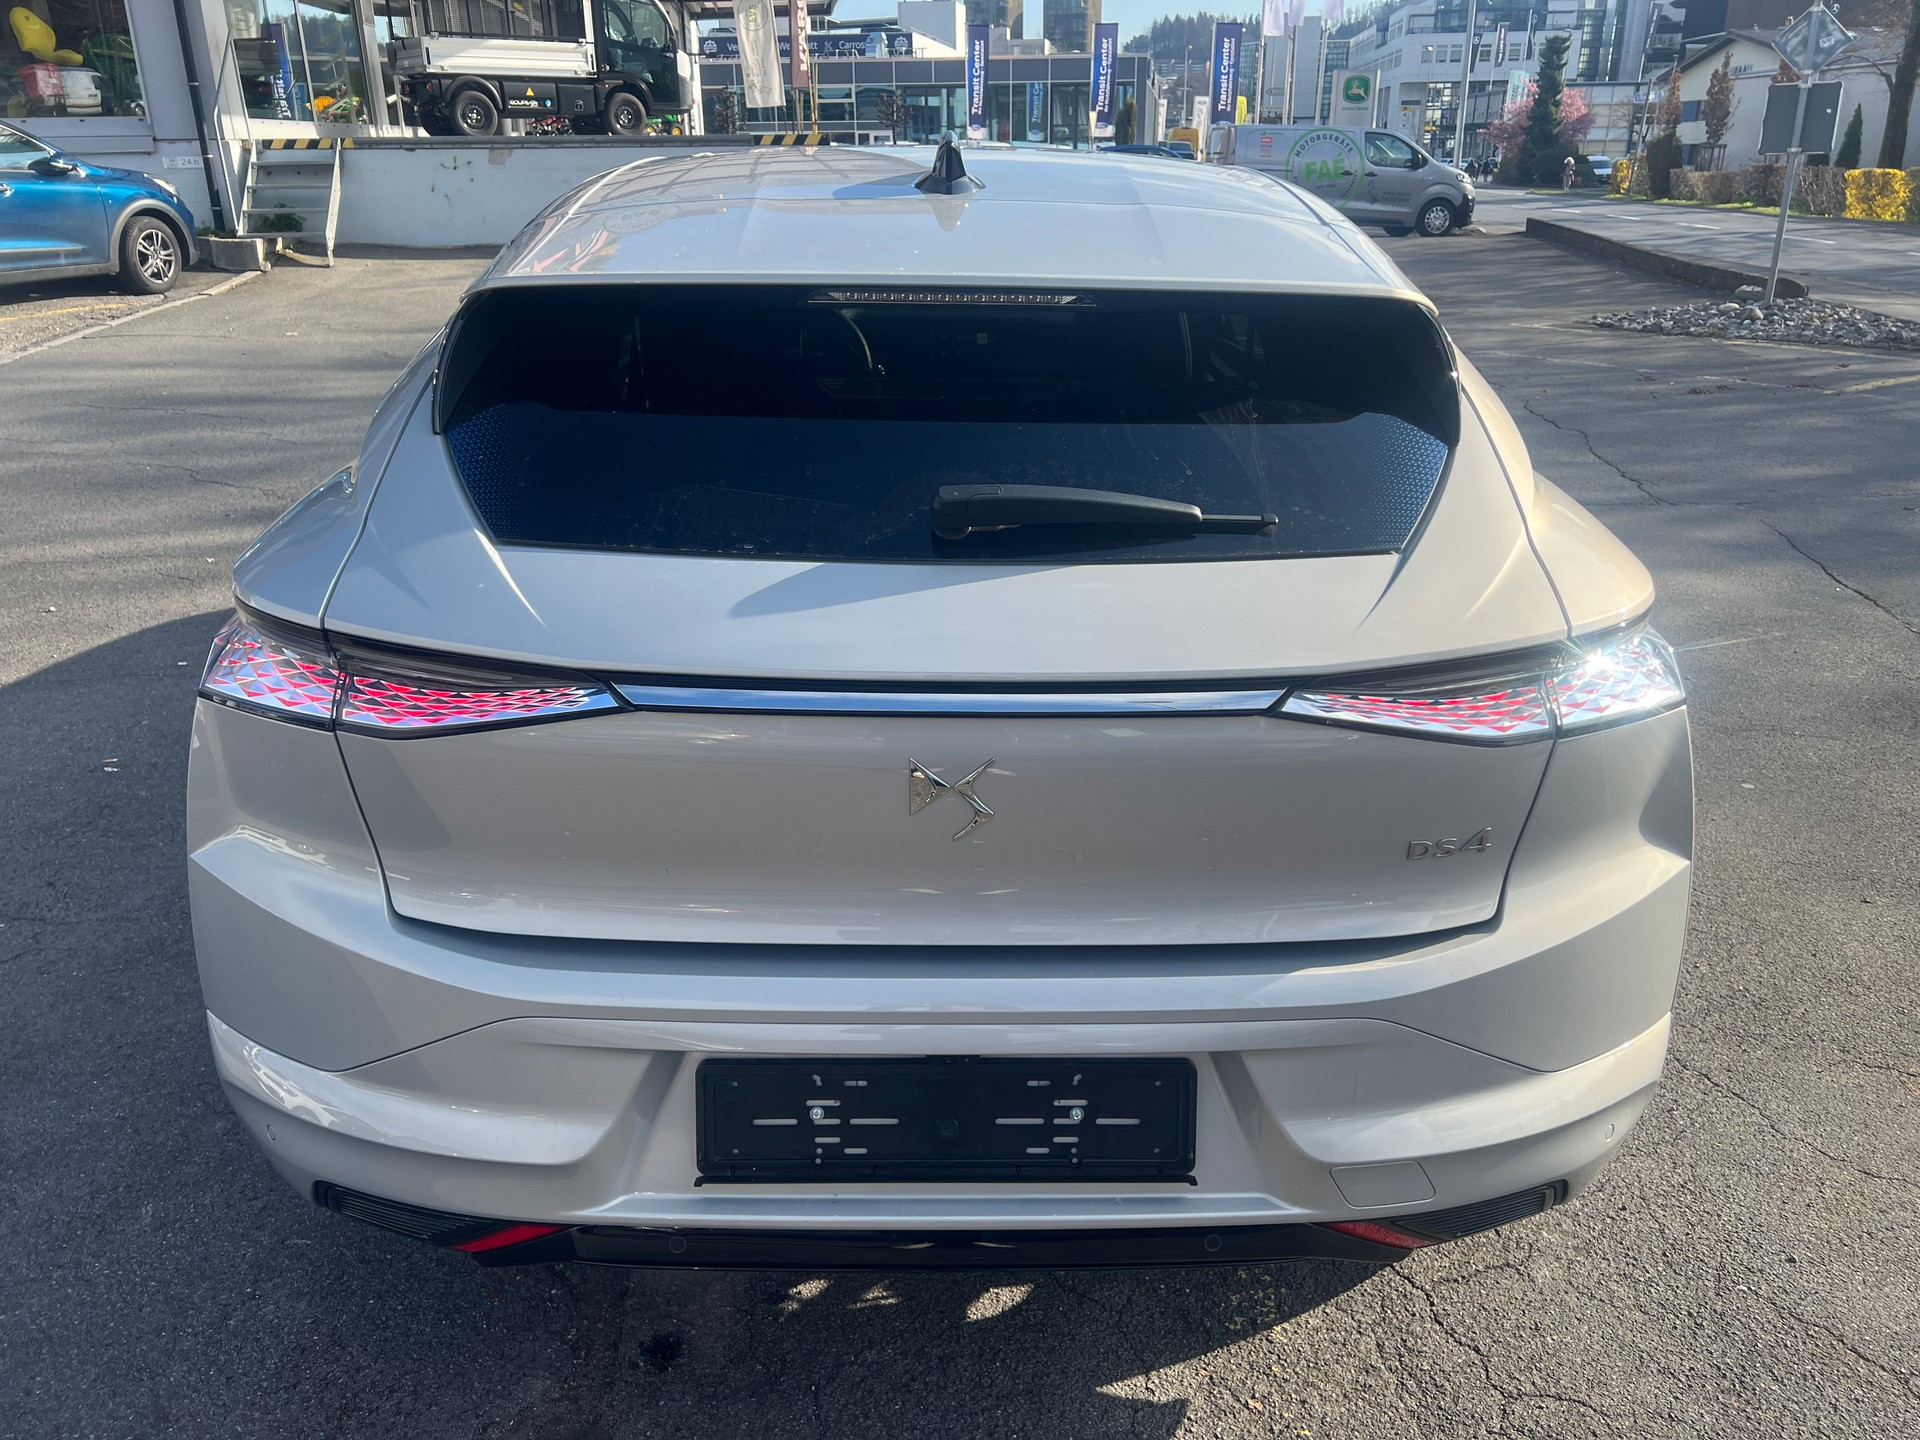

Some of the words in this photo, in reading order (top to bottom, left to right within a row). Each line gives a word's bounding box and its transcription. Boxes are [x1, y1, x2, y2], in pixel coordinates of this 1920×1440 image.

[838, 40, 866, 49] Carros
[972, 40, 980, 76] Center
[1099, 38, 1108, 74] Center
[1221, 37, 1230, 74] Center
[971, 77, 980, 115] Transit
[1095, 75, 1106, 113] Transit
[1218, 75, 1228, 112] Transit
[1305, 152, 1345, 182] FAÉ
